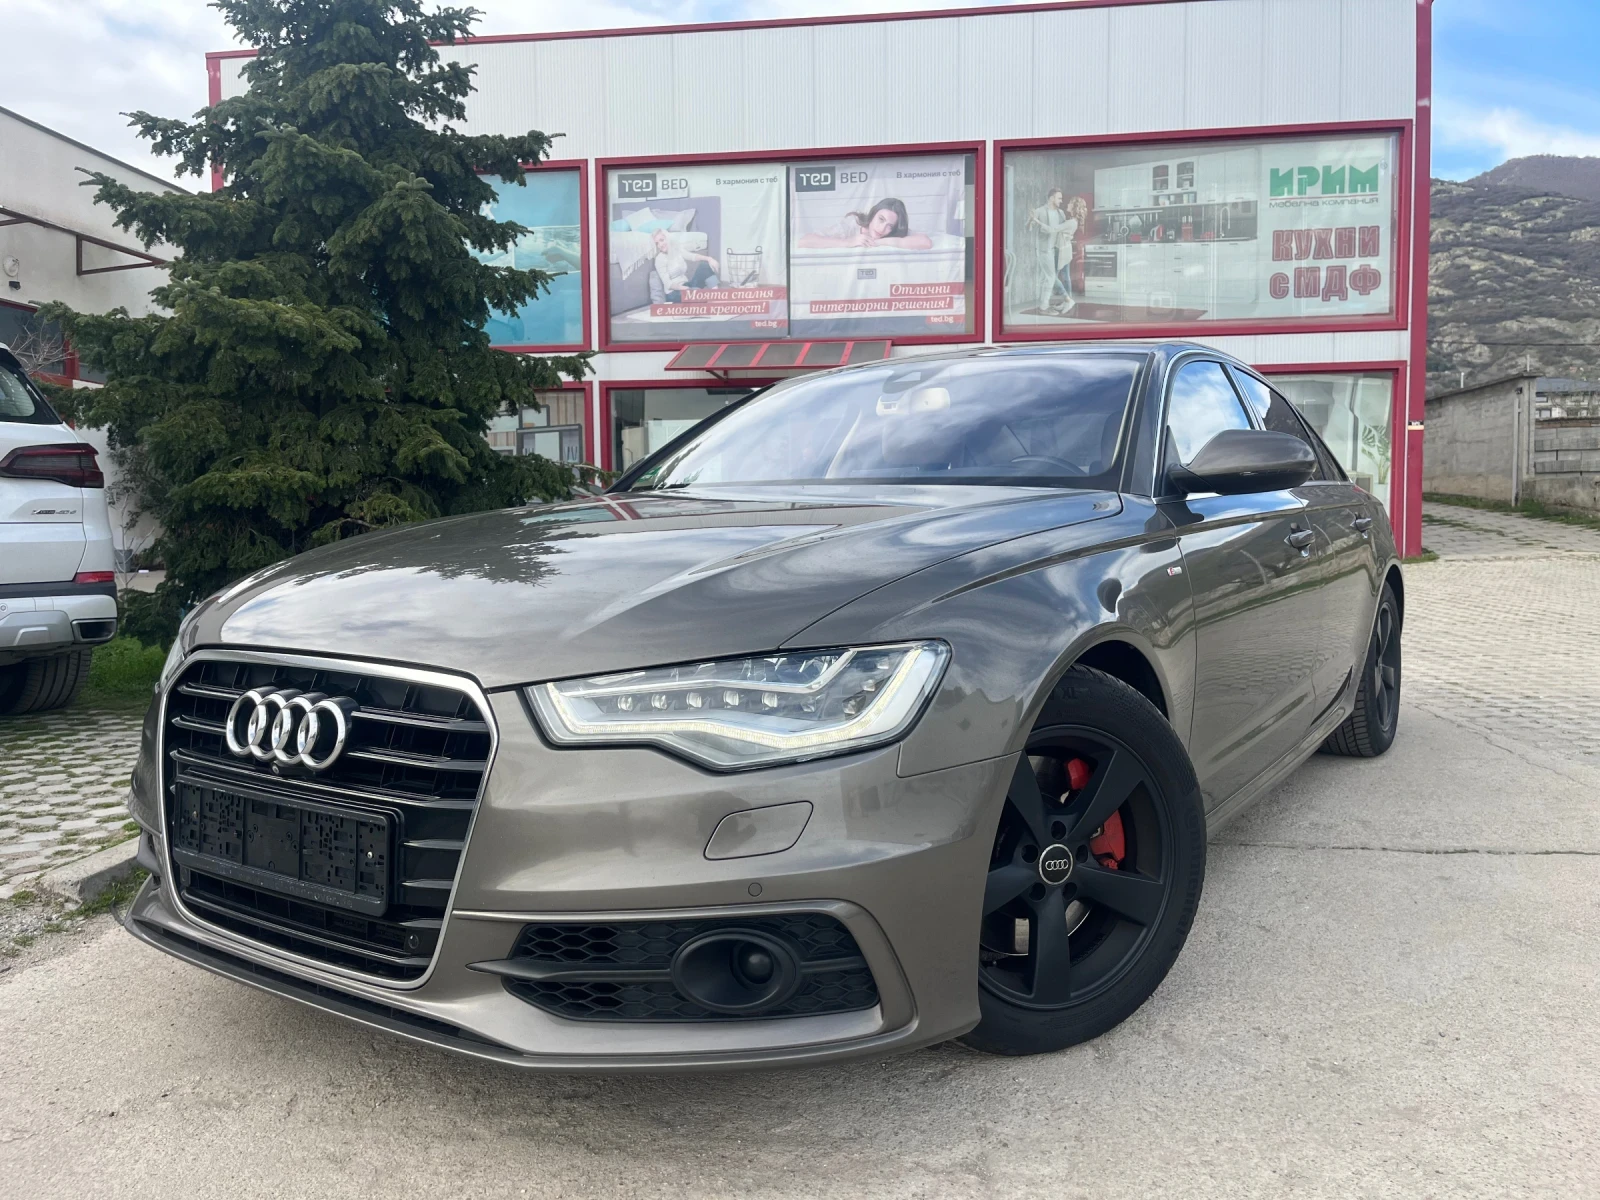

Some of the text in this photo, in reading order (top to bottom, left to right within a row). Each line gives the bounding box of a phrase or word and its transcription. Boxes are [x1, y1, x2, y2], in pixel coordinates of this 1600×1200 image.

[840, 171, 868, 184] BED
[896, 171, 903, 179] В
[903, 171, 941, 180] хармония
[1269, 163, 1379, 197] ИРИМ
[661, 178, 688, 190] BED
[722, 178, 759, 186] хармония
[1272, 225, 1380, 261] КУХНИ
[1293, 264, 1381, 302] МДФ
[684, 289, 773, 300] Моята спалня
[891, 284, 950, 295] Отлични
[656, 303, 766, 316] е моята крепост!
[811, 298, 950, 313] интериорни решения!
[755, 320, 778, 328] ted.bg
[930, 315, 954, 324] ted.bg
